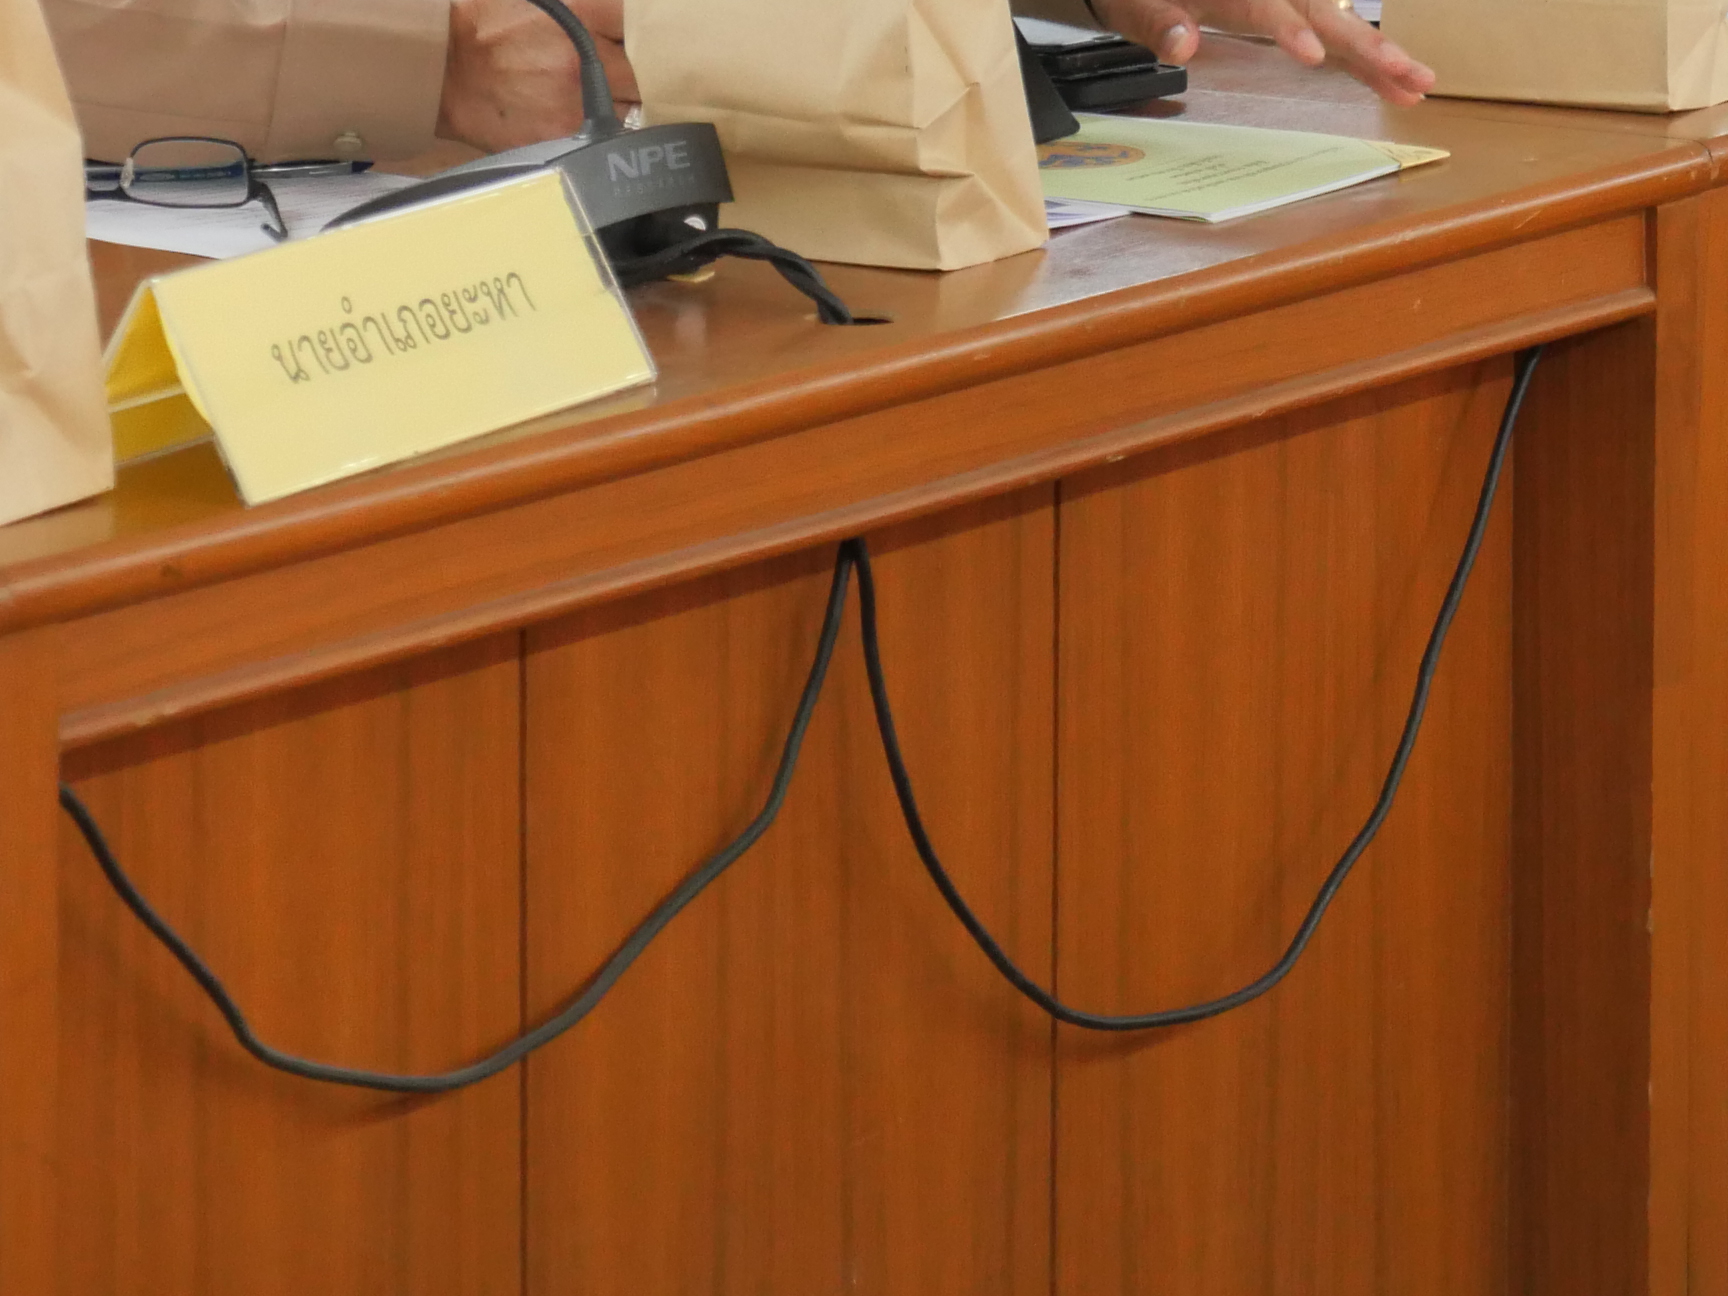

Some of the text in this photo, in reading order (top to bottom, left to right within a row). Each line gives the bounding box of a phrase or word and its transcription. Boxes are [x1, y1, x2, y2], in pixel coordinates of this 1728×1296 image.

[606, 140, 691, 182] NPE
[270, 271, 537, 384] นายอำเภอยะหา
